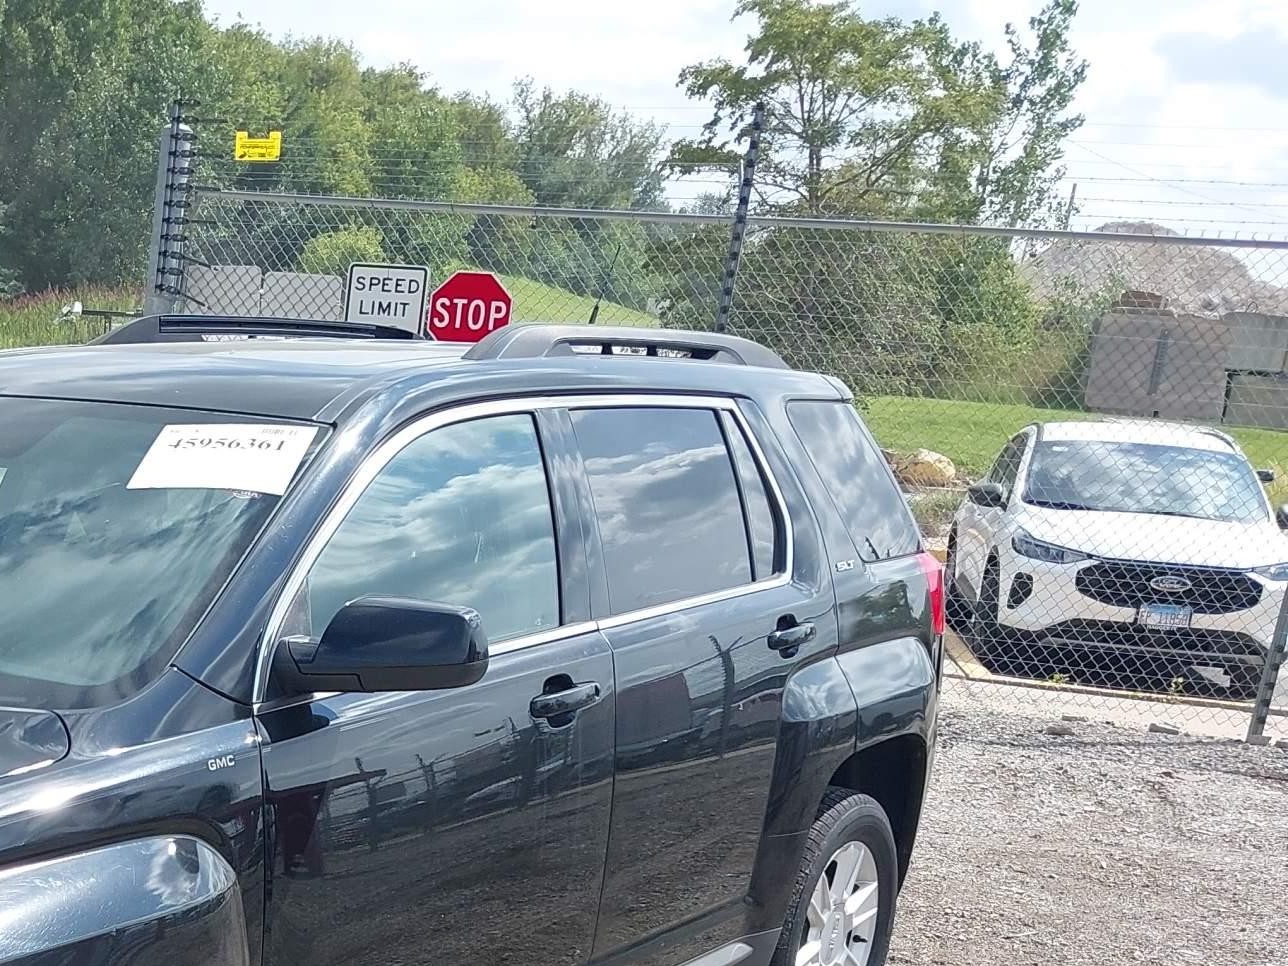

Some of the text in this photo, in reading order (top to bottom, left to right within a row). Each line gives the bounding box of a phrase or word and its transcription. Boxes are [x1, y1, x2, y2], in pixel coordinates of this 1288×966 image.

[355, 276, 420, 294] SPEED
[359, 300, 410, 317] LIMIT
[433, 297, 507, 331] STOP
[168, 438, 287, 451] 45956361
[208, 755, 235, 770] GMC
